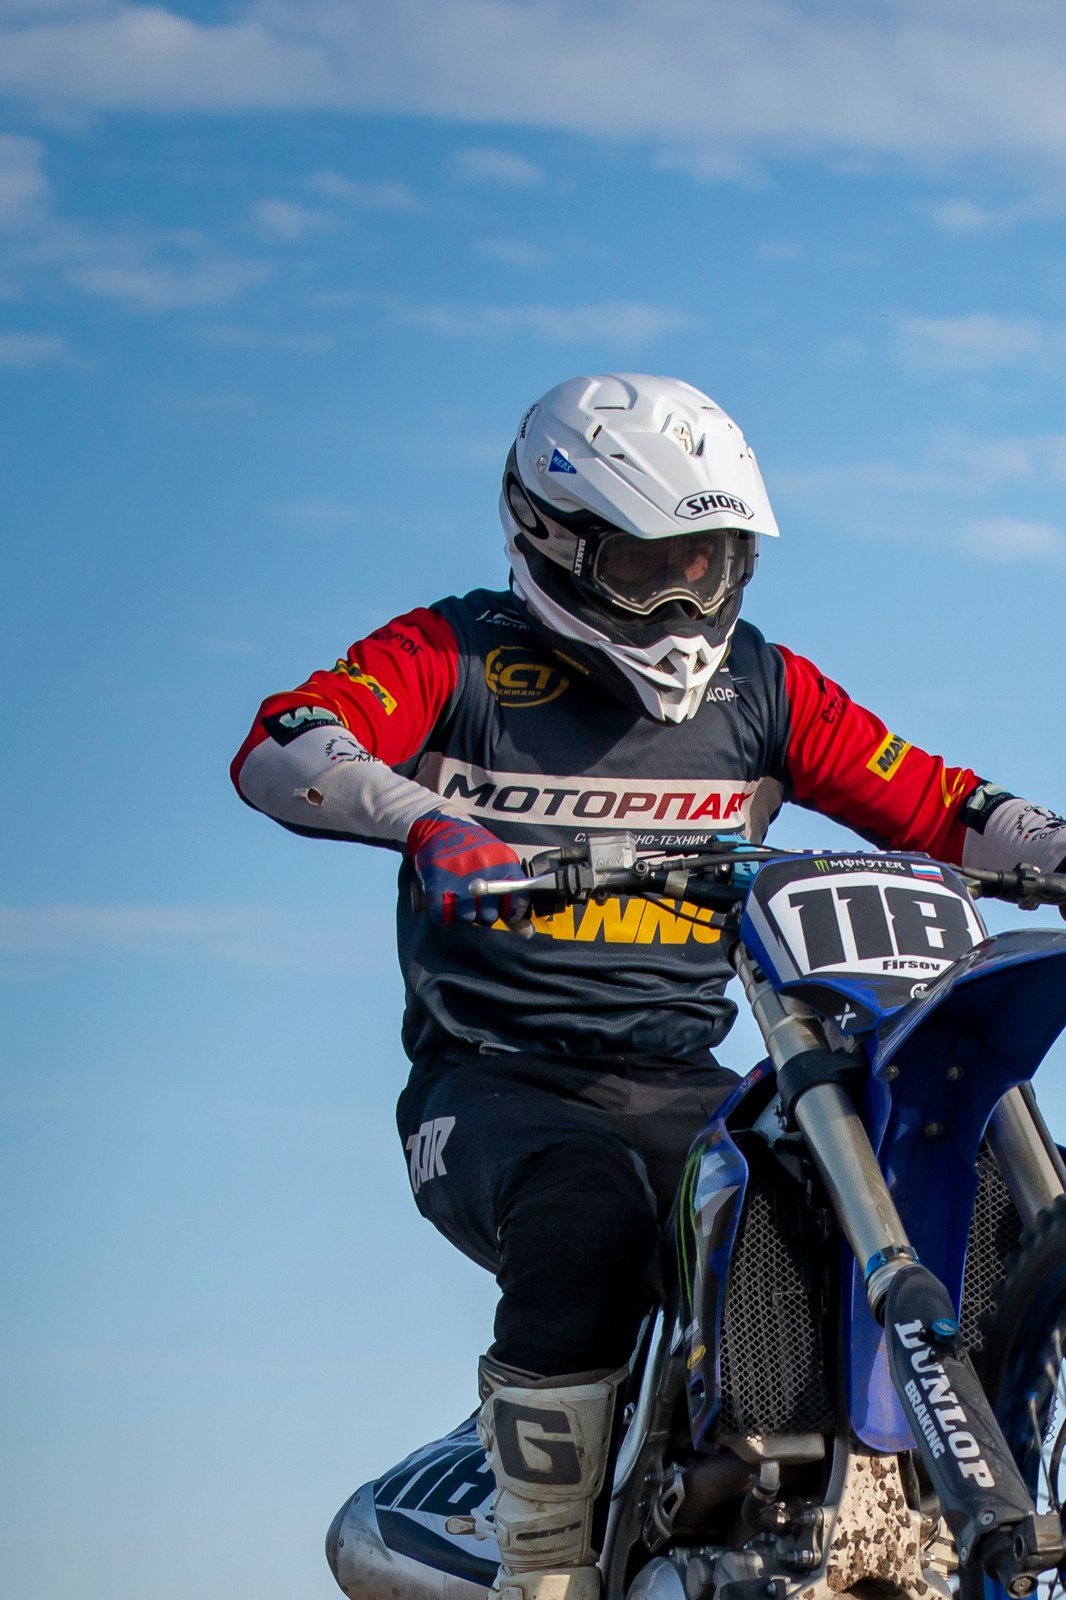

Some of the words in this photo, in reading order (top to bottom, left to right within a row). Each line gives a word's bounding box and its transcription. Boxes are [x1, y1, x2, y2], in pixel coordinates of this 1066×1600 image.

[686, 496, 746, 517] SHOEI
[573, 538, 586, 577] OAKLEY
[829, 858, 906, 871] MONSTER
[788, 885, 974, 972] 118
[882, 959, 942, 972] Firsov
[894, 1319, 996, 1488] DUNLOP
[904, 1379, 946, 1459] BRAKING
